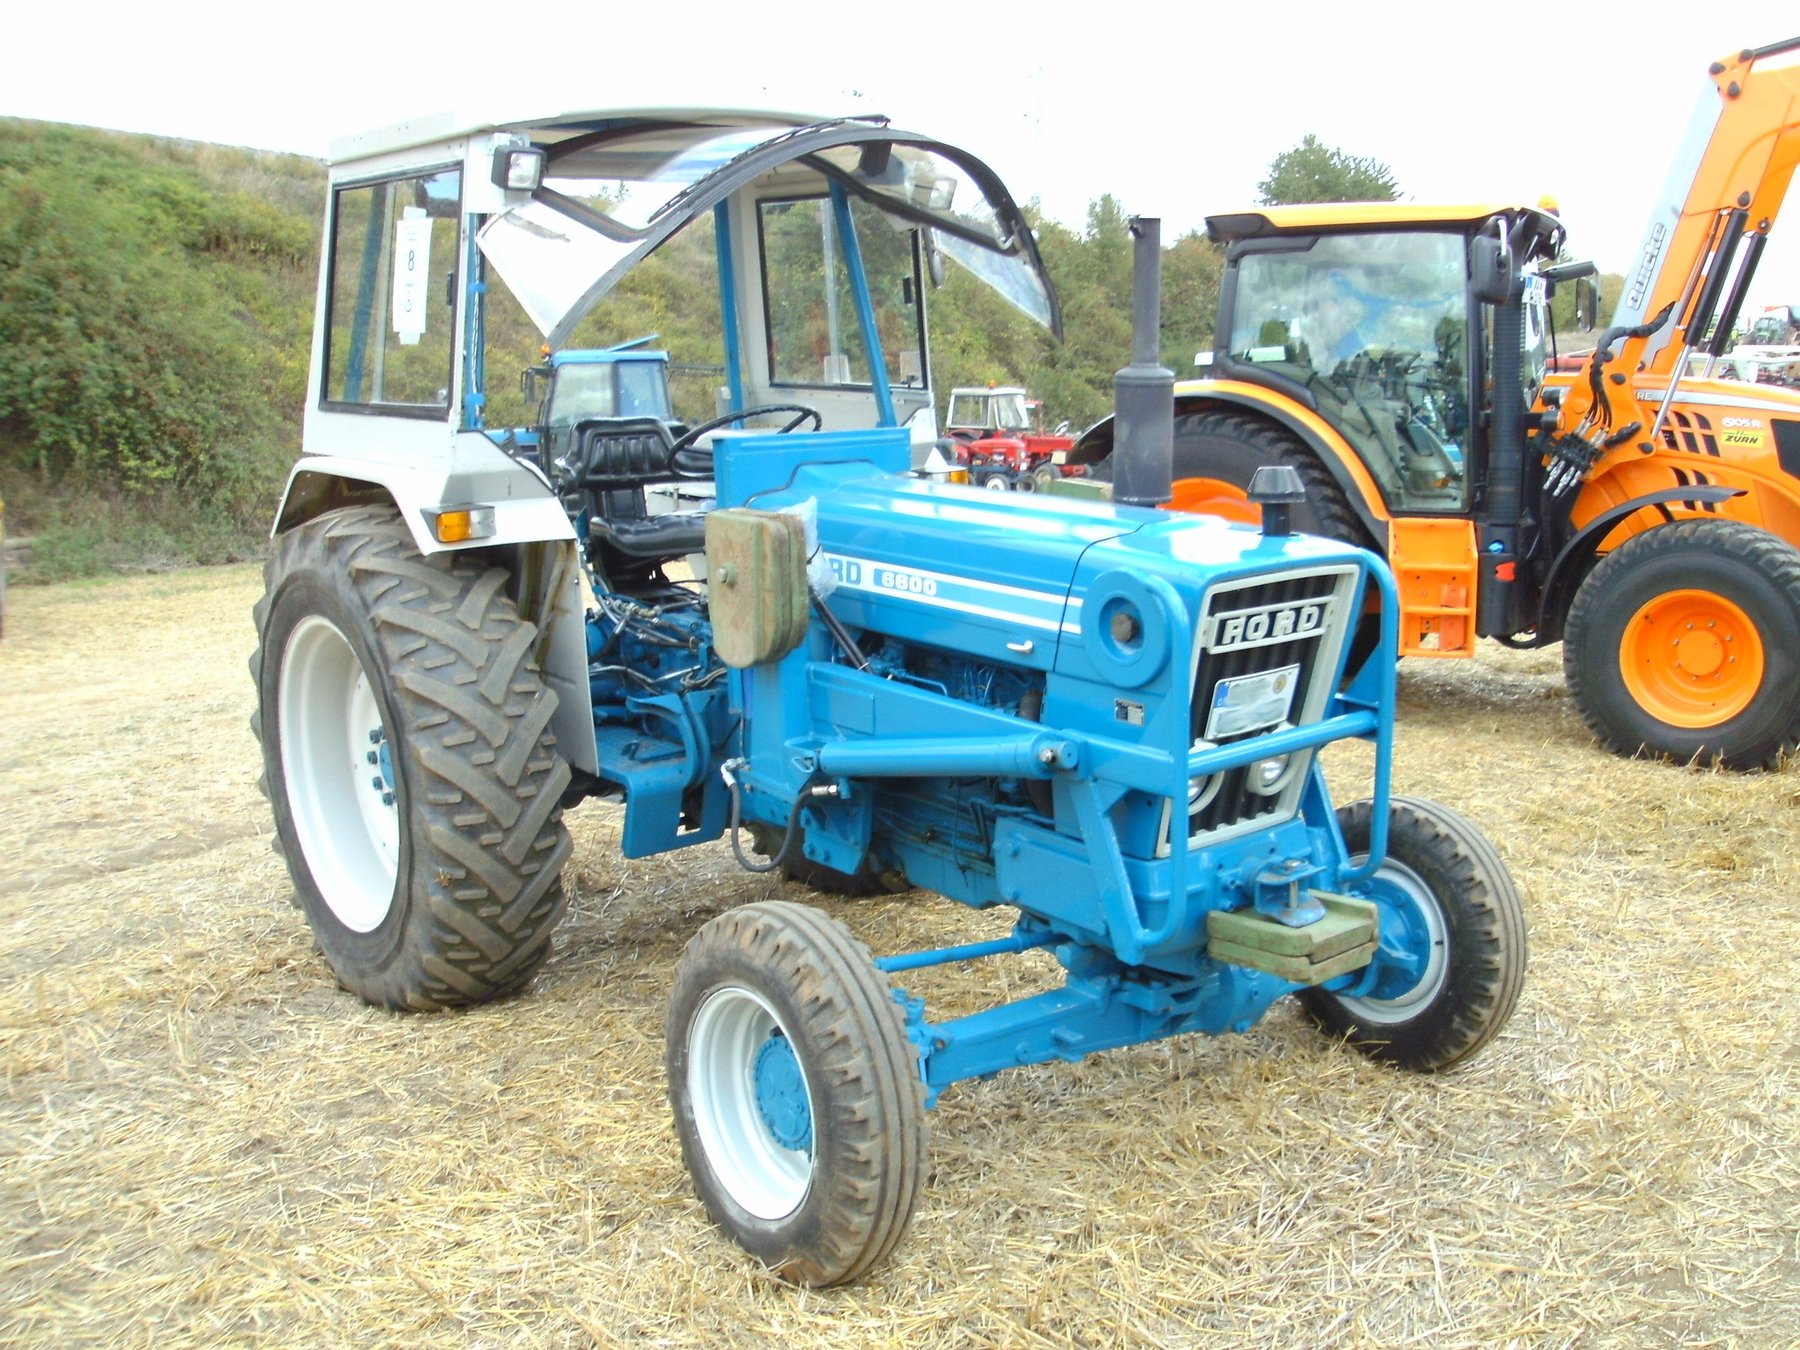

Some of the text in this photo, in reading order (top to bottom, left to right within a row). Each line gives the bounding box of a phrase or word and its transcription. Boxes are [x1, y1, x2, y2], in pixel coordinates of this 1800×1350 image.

[1625, 222, 1667, 311] Quicke
[828, 557, 862, 586] RD
[1221, 604, 1319, 646] FORD
